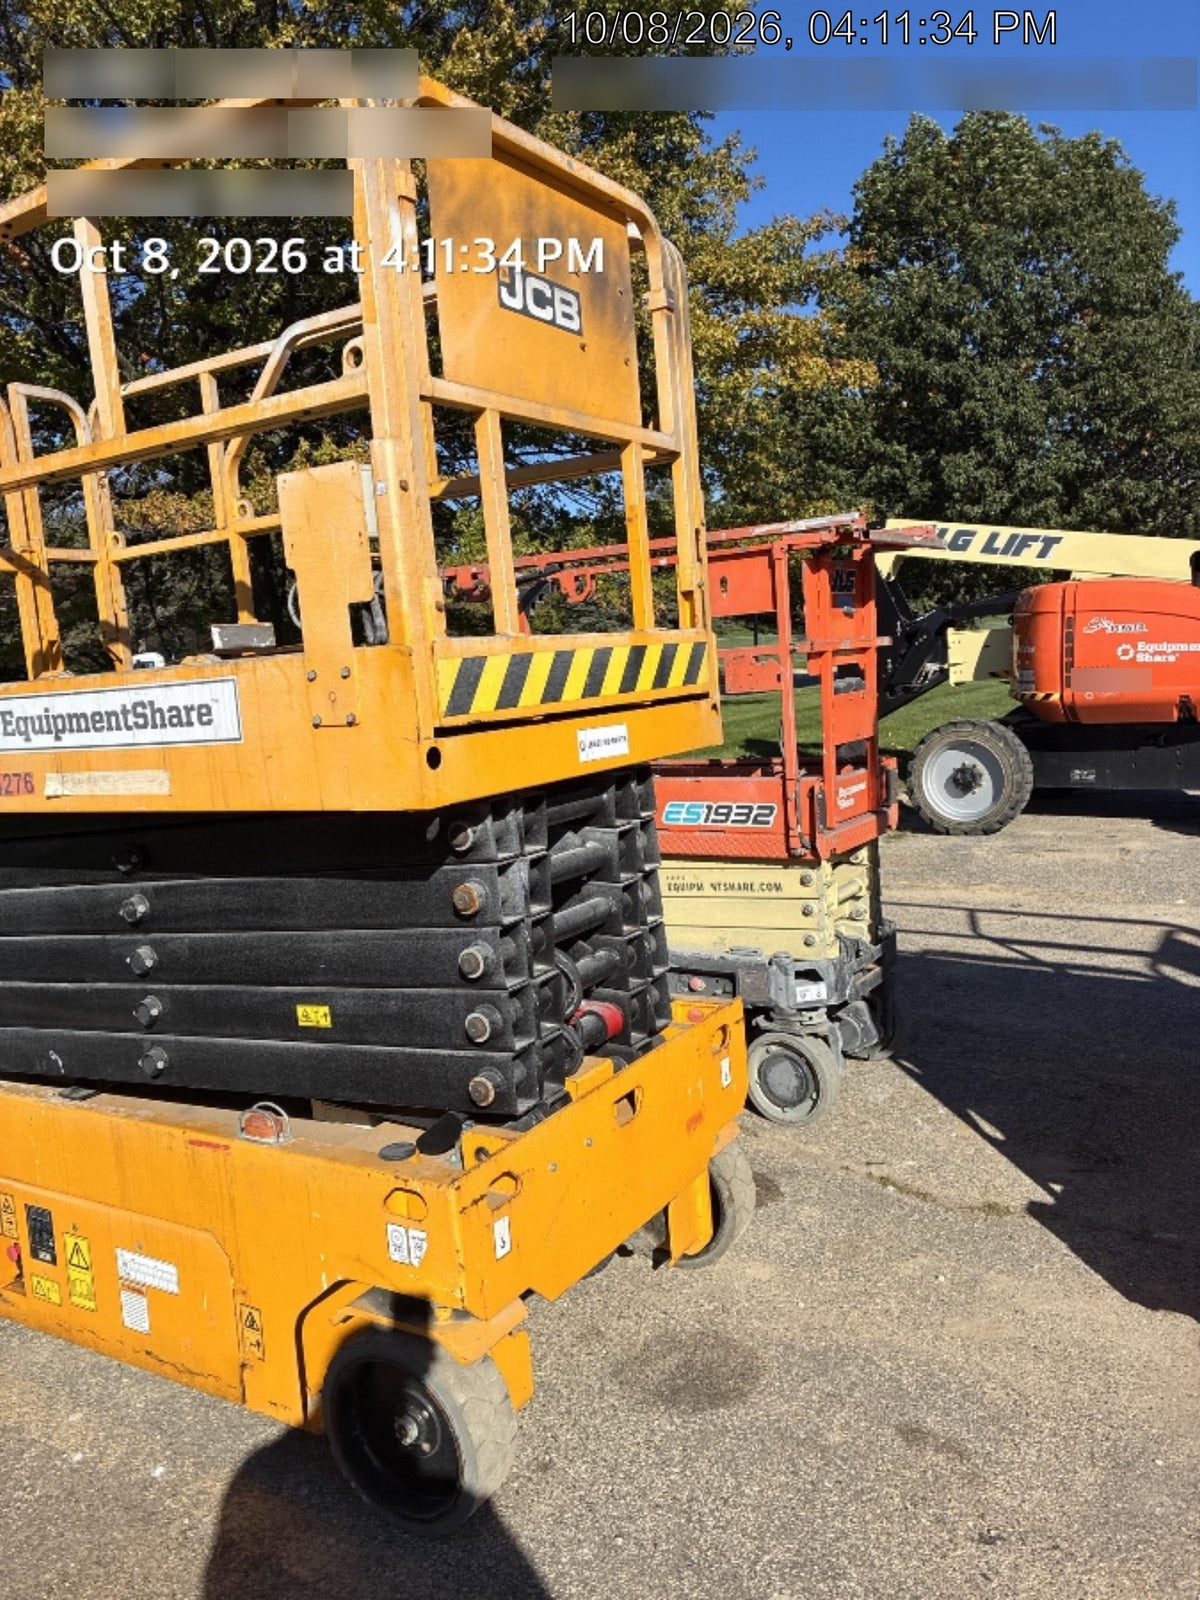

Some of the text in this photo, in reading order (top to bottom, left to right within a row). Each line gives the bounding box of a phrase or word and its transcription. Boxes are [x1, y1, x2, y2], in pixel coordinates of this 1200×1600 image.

[500, 269, 580, 331] JCB
[980, 531, 1064, 559] LIFT
[0, 700, 214, 742] EquipmentShare
[0, 772, 35, 795] 276
[664, 803, 776, 826] ES1932
